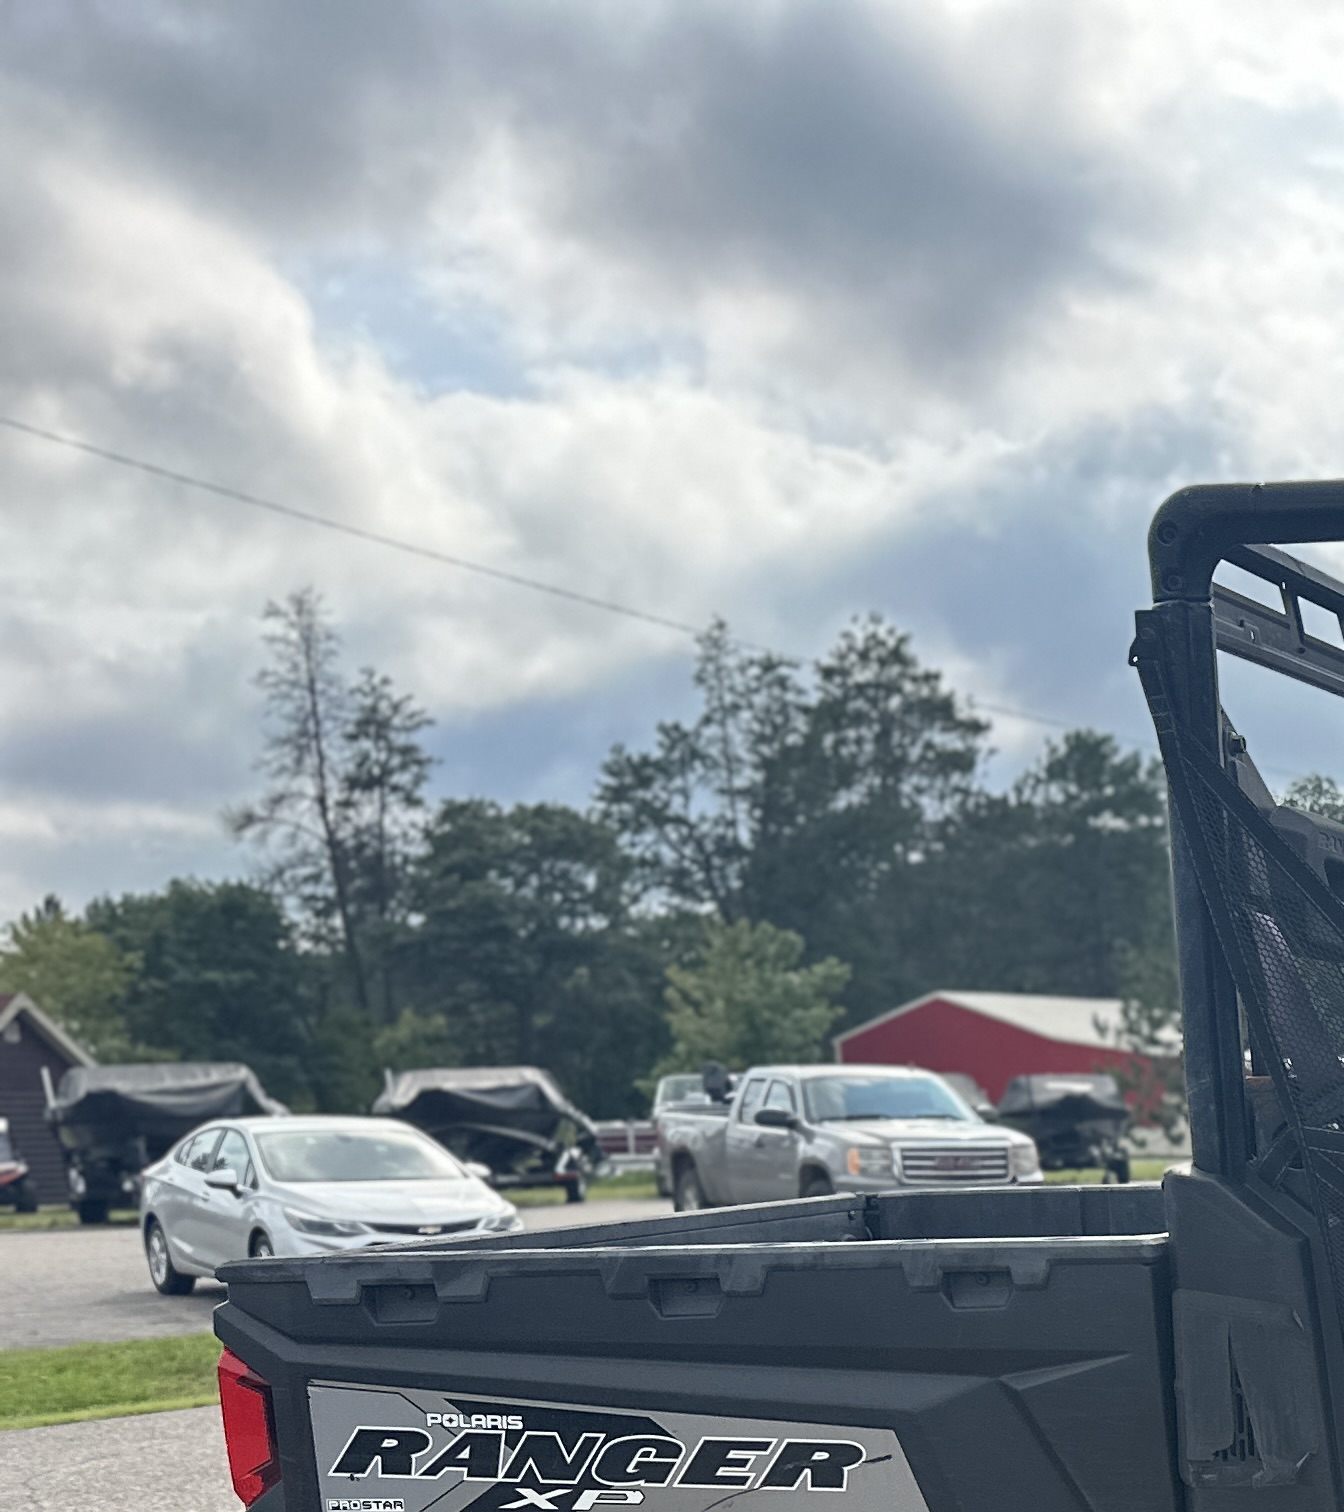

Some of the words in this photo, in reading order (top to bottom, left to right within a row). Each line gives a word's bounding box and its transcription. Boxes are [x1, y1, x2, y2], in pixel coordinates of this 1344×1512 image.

[426, 1412, 524, 1430] POLARIS
[327, 1425, 868, 1492] RANGER
[328, 1499, 404, 1511] PROSTAR
[499, 1489, 646, 1511] XP
